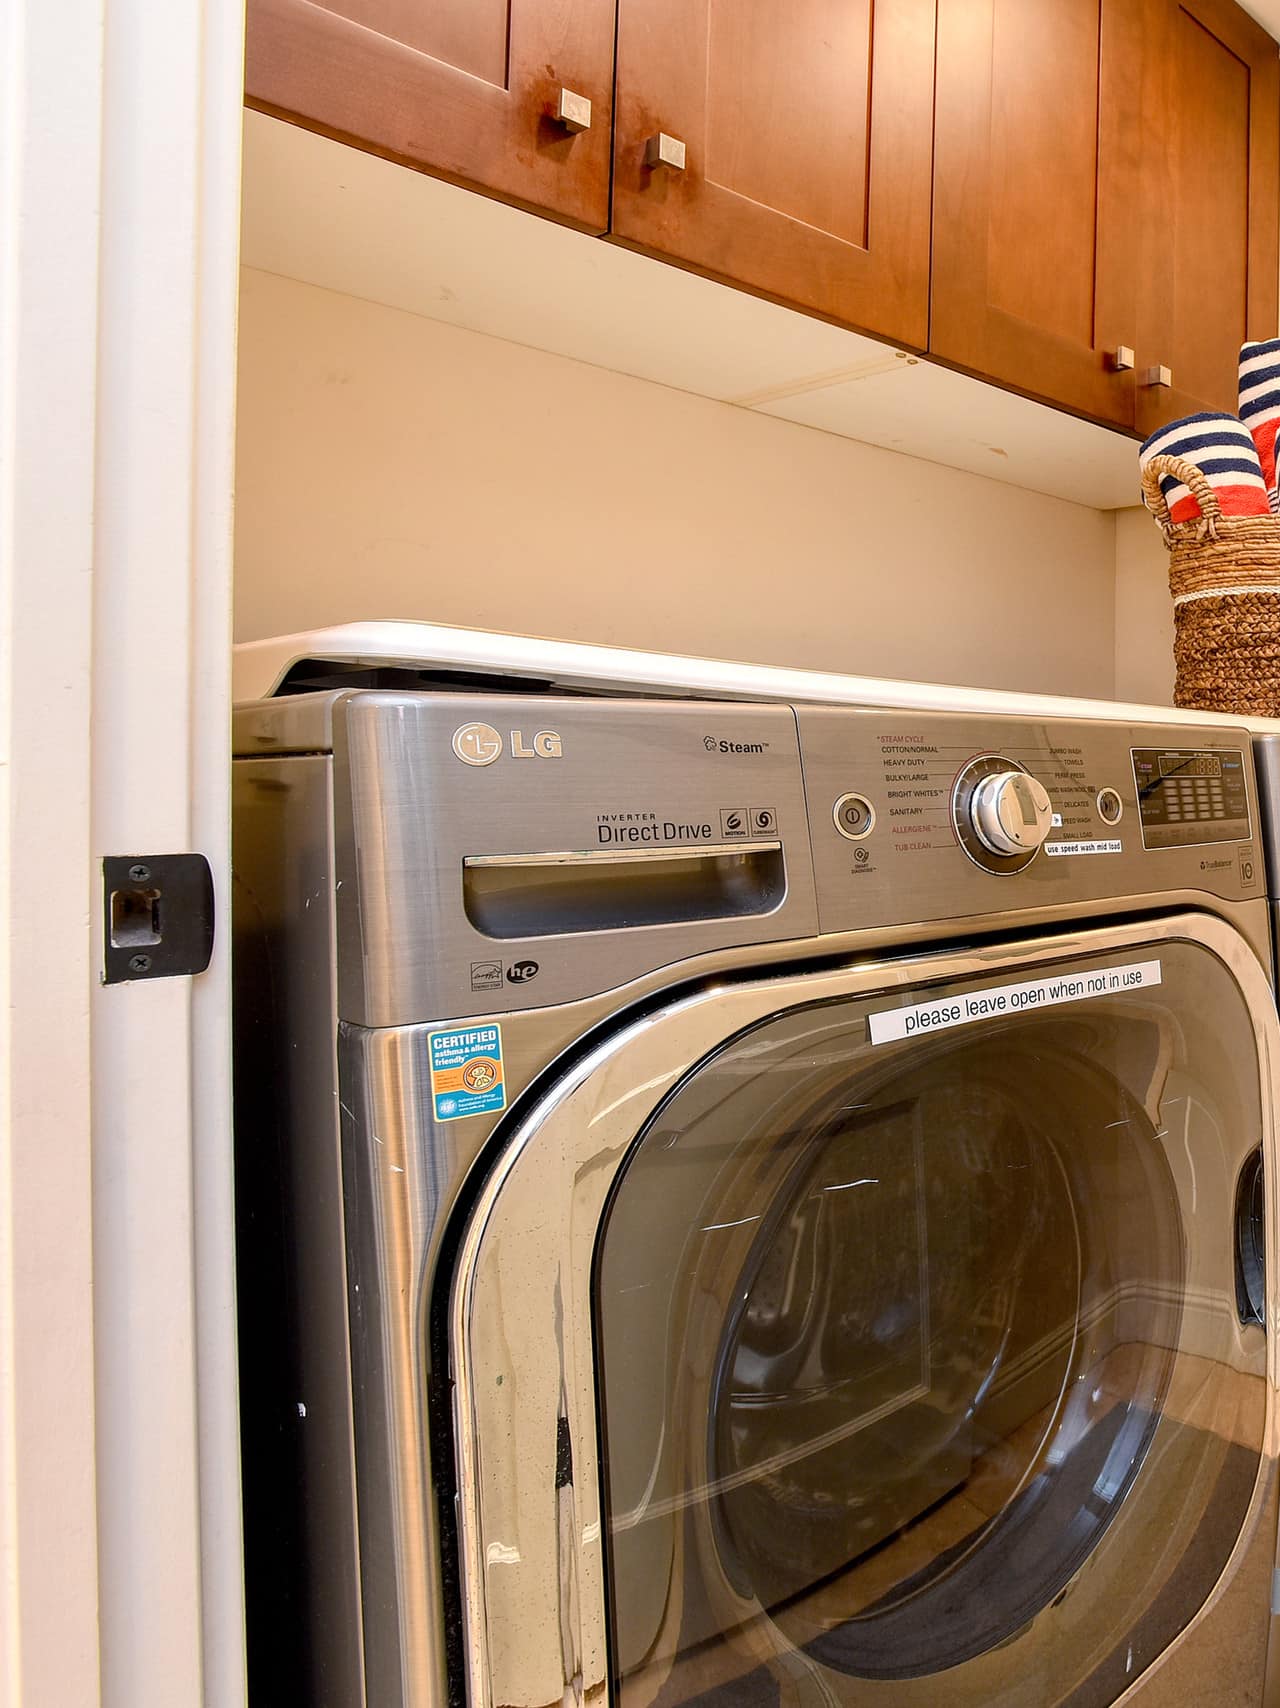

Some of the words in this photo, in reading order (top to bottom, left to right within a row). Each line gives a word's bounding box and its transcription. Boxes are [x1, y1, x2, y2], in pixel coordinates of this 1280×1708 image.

[510, 730, 562, 758] LG
[905, 735, 924, 743] CYCLE
[597, 813, 656, 822] INVERTER
[889, 808, 923, 816] SANITARY
[598, 823, 660, 843] Direct
[663, 822, 712, 840] Drive
[909, 842, 931, 850] CLEAN
[1061, 845, 1079, 854] speed
[1080, 844, 1096, 852] wash
[1096, 843, 1107, 851] mid
[1108, 842, 1121, 850] load
[904, 1004, 961, 1034] please
[965, 994, 1006, 1017] leave
[1010, 987, 1046, 1009] open
[1049, 979, 1084, 999] when
[1087, 975, 1107, 993] not
[1109, 972, 1120, 988] in
[1122, 970, 1143, 986] use
[433, 1030, 496, 1049] CERTIFIED
[435, 1048, 463, 1058] asthma
[470, 1043, 496, 1053] allergy
